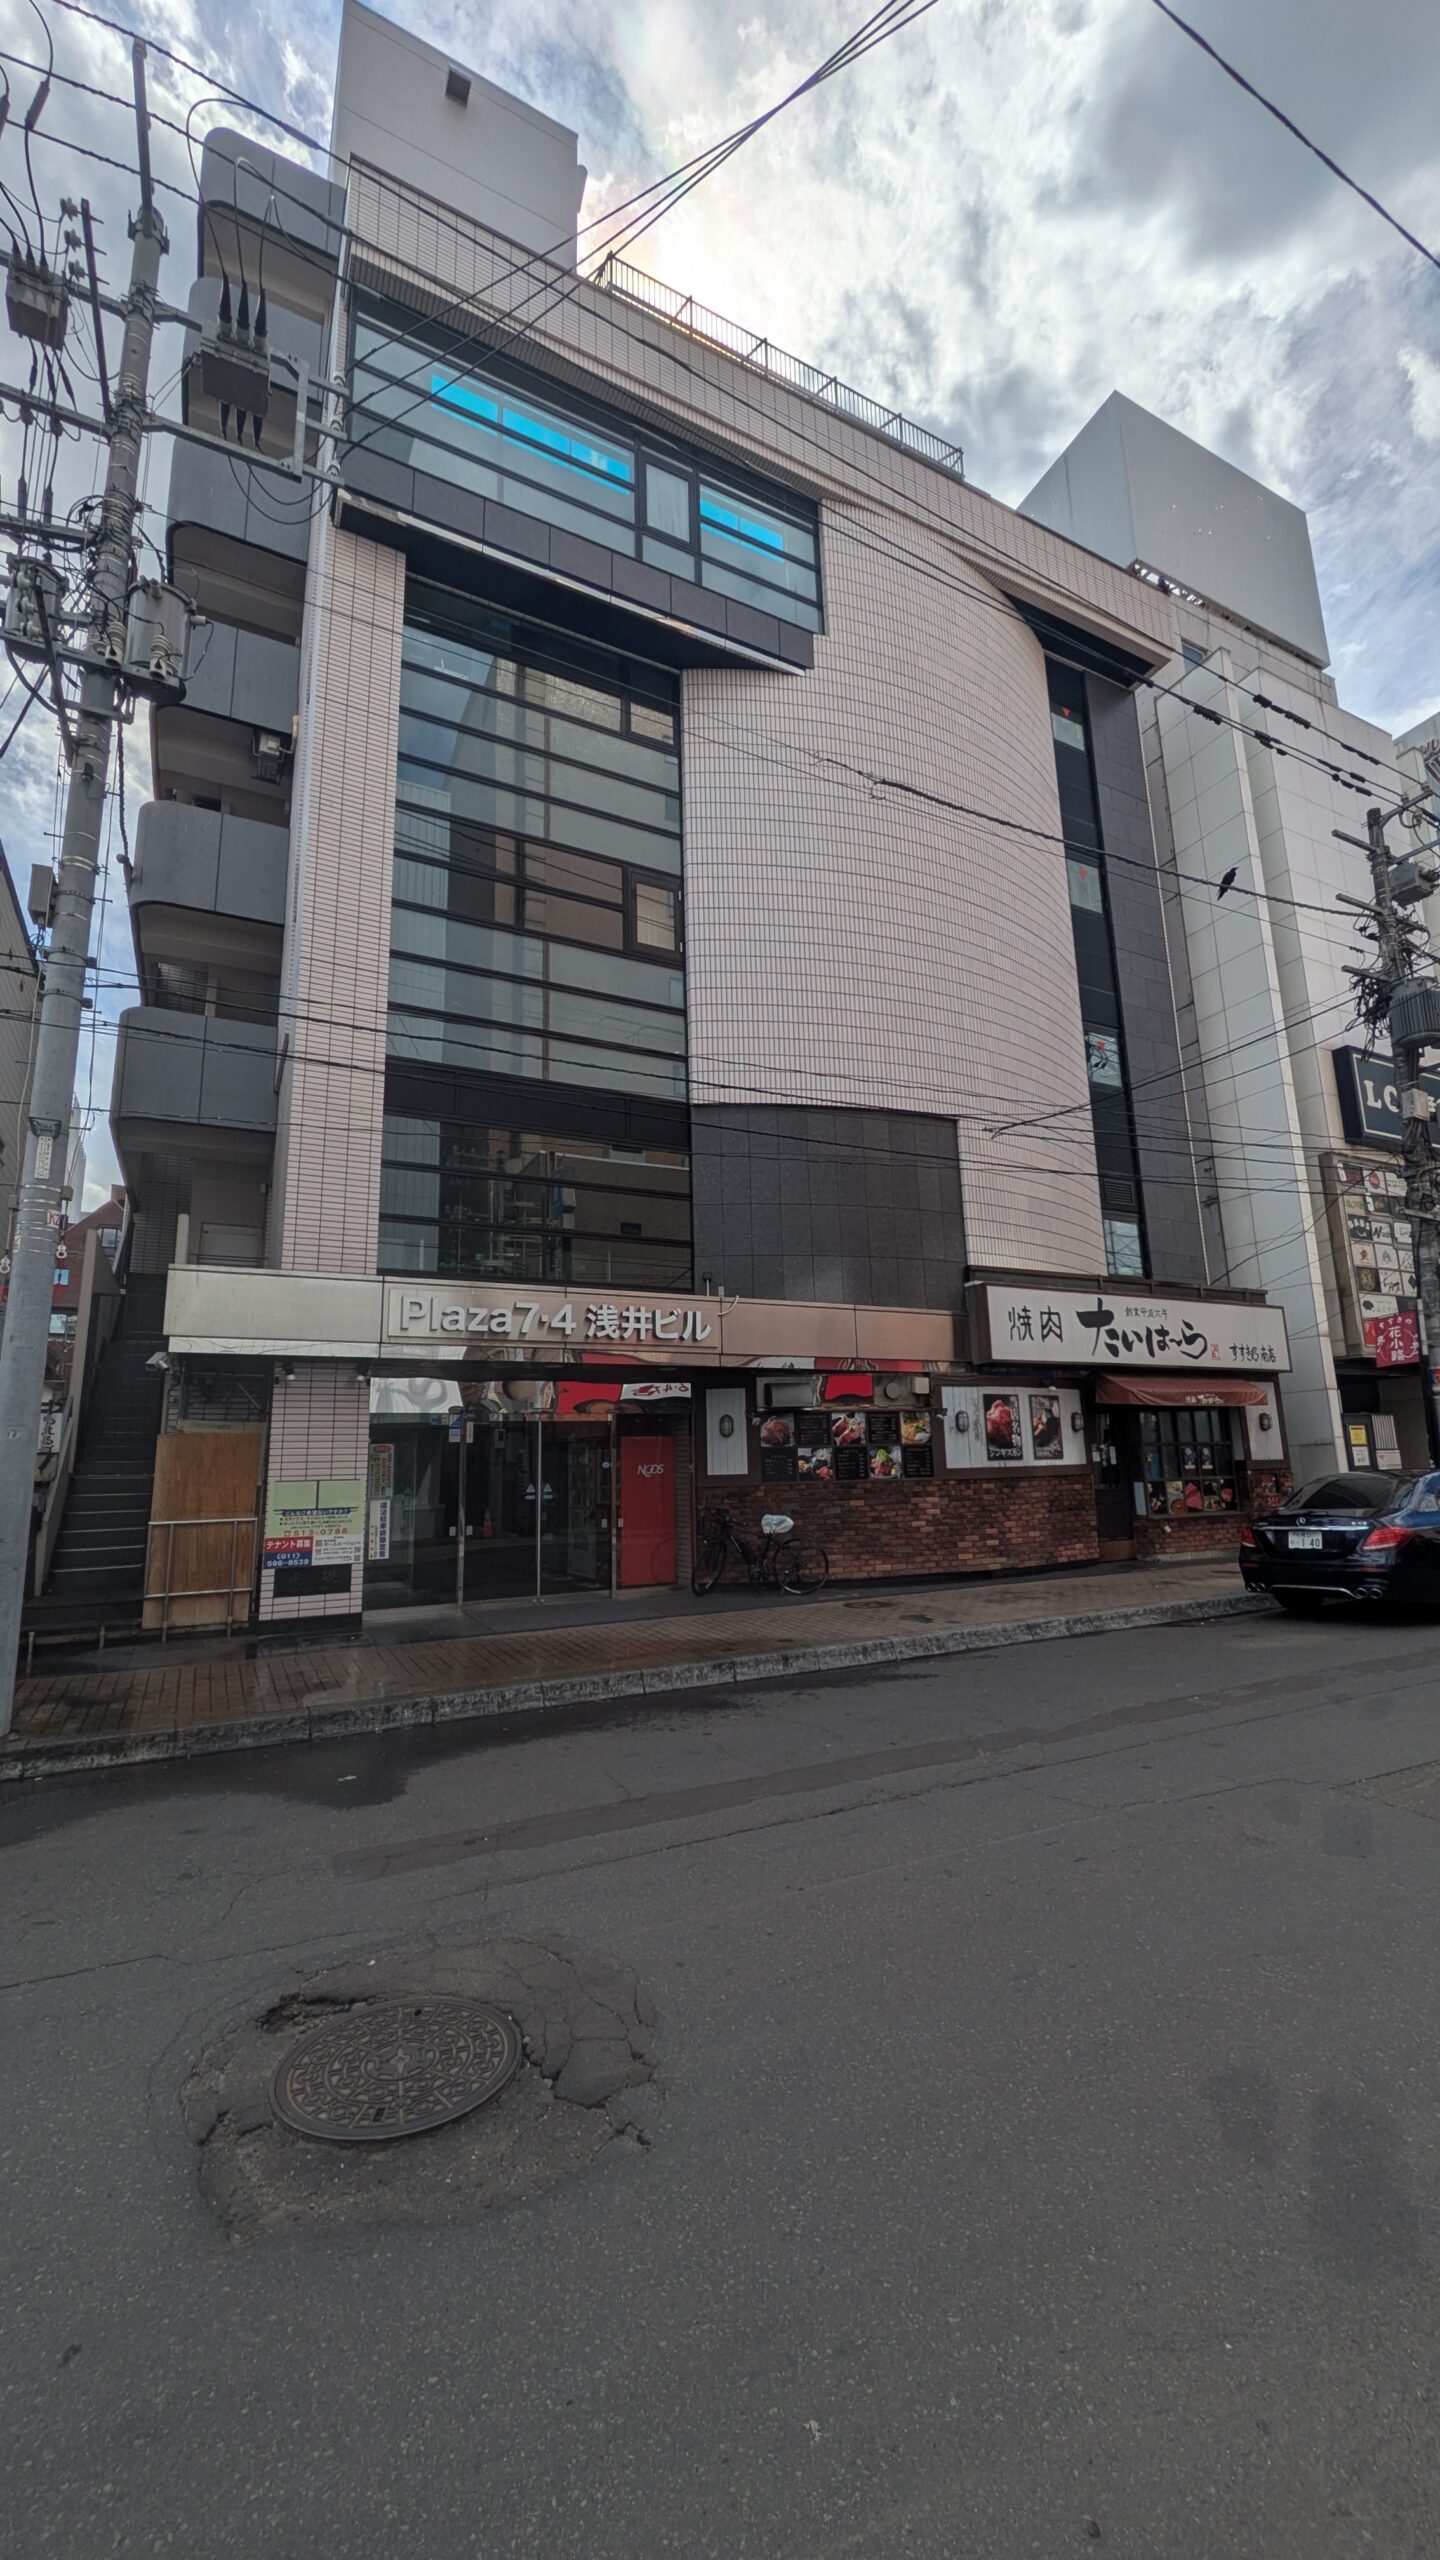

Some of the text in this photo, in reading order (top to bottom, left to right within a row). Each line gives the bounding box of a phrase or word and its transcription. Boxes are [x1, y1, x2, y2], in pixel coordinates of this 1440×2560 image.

[586, 1303, 712, 1341] 浅井ビル
[1008, 1305, 1063, 1343] 焼肉
[1387, 1326, 1406, 1362] 花小路
[266, 1540, 311, 1550] テナント募集
